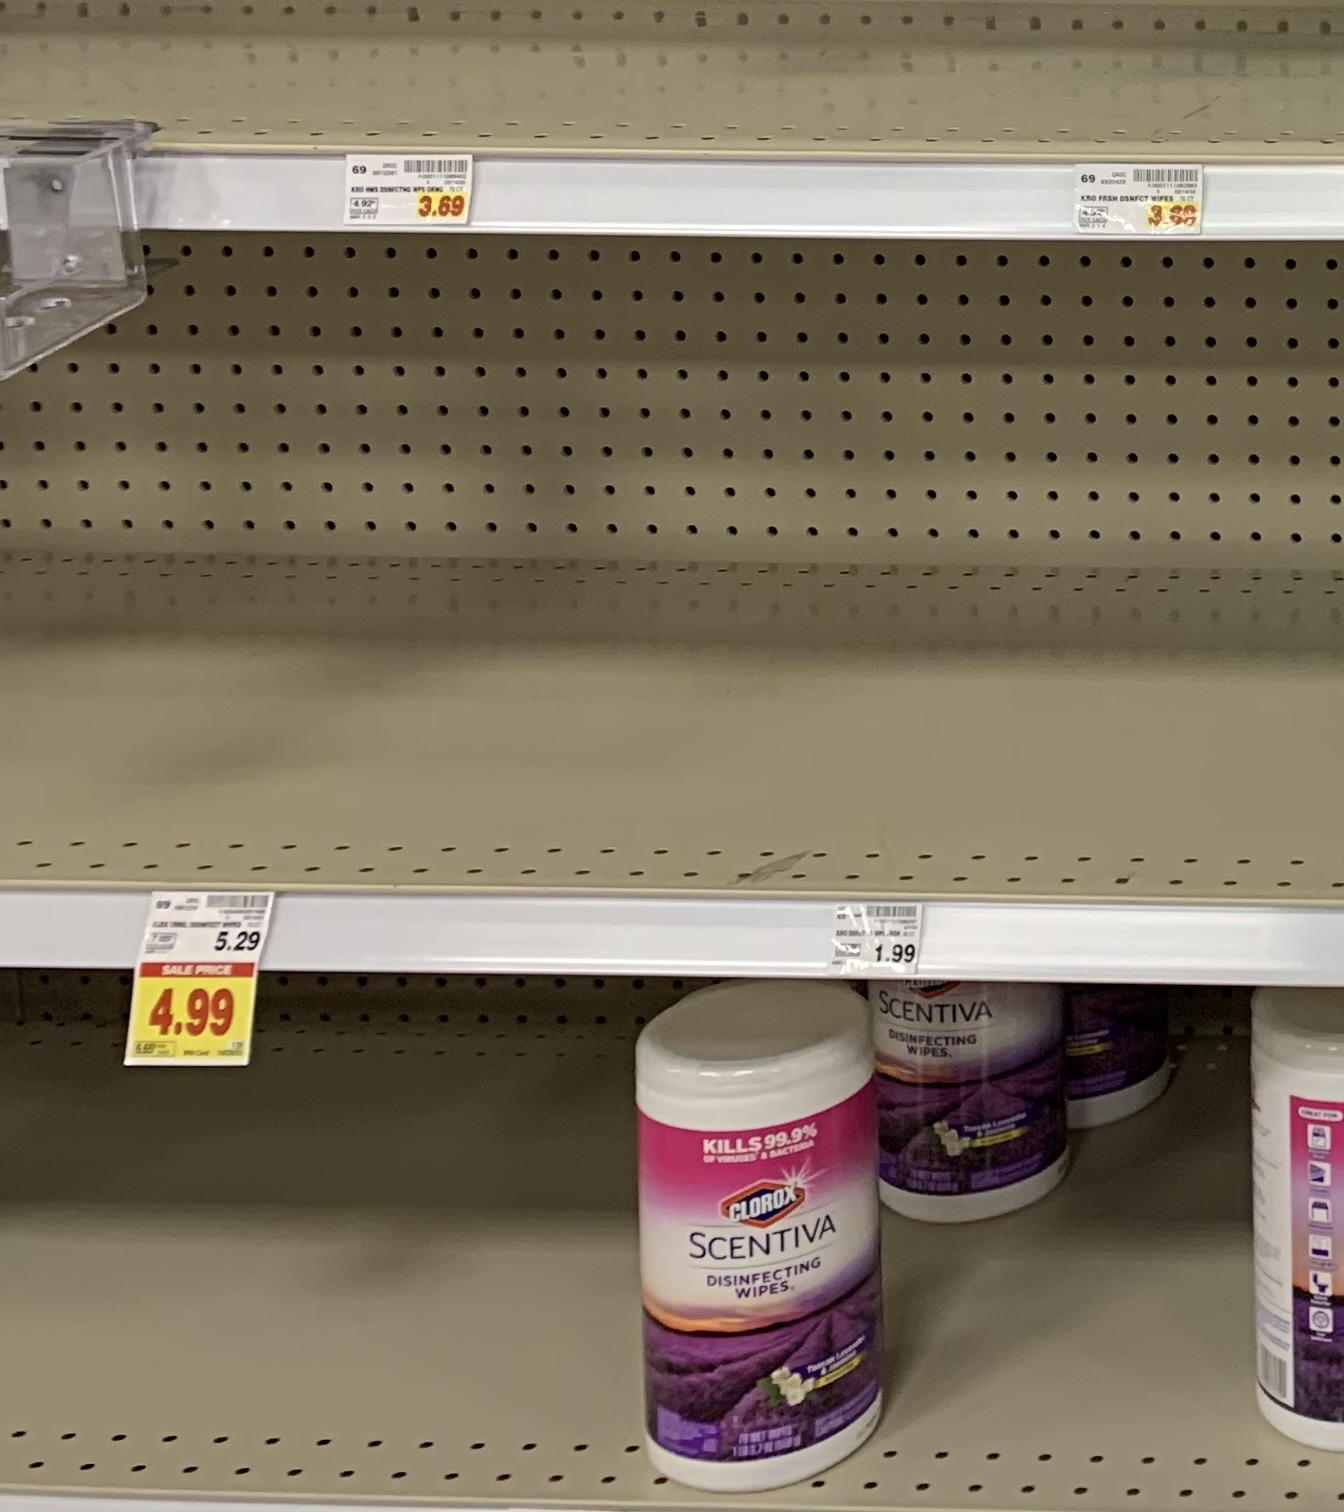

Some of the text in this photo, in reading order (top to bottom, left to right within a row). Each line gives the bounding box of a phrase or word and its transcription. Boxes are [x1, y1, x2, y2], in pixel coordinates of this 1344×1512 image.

[351, 165, 367, 175] 69
[1080, 174, 1096, 183] 69
[417, 195, 466, 218] 3.69
[214, 930, 261, 952] 5.29
[874, 943, 916, 963] 1.99
[161, 963, 233, 976] SALE PRICE
[148, 987, 234, 1037] 4.99
[878, 990, 993, 1024] SCENTIVA
[888, 1029, 977, 1047] DISINFECTING
[703, 1122, 818, 1155] KILLS 99.9%
[728, 1184, 798, 1223] CLOROX
[688, 1213, 837, 1261] SCENTIVA
[706, 1256, 822, 1288] DISINFECTING
